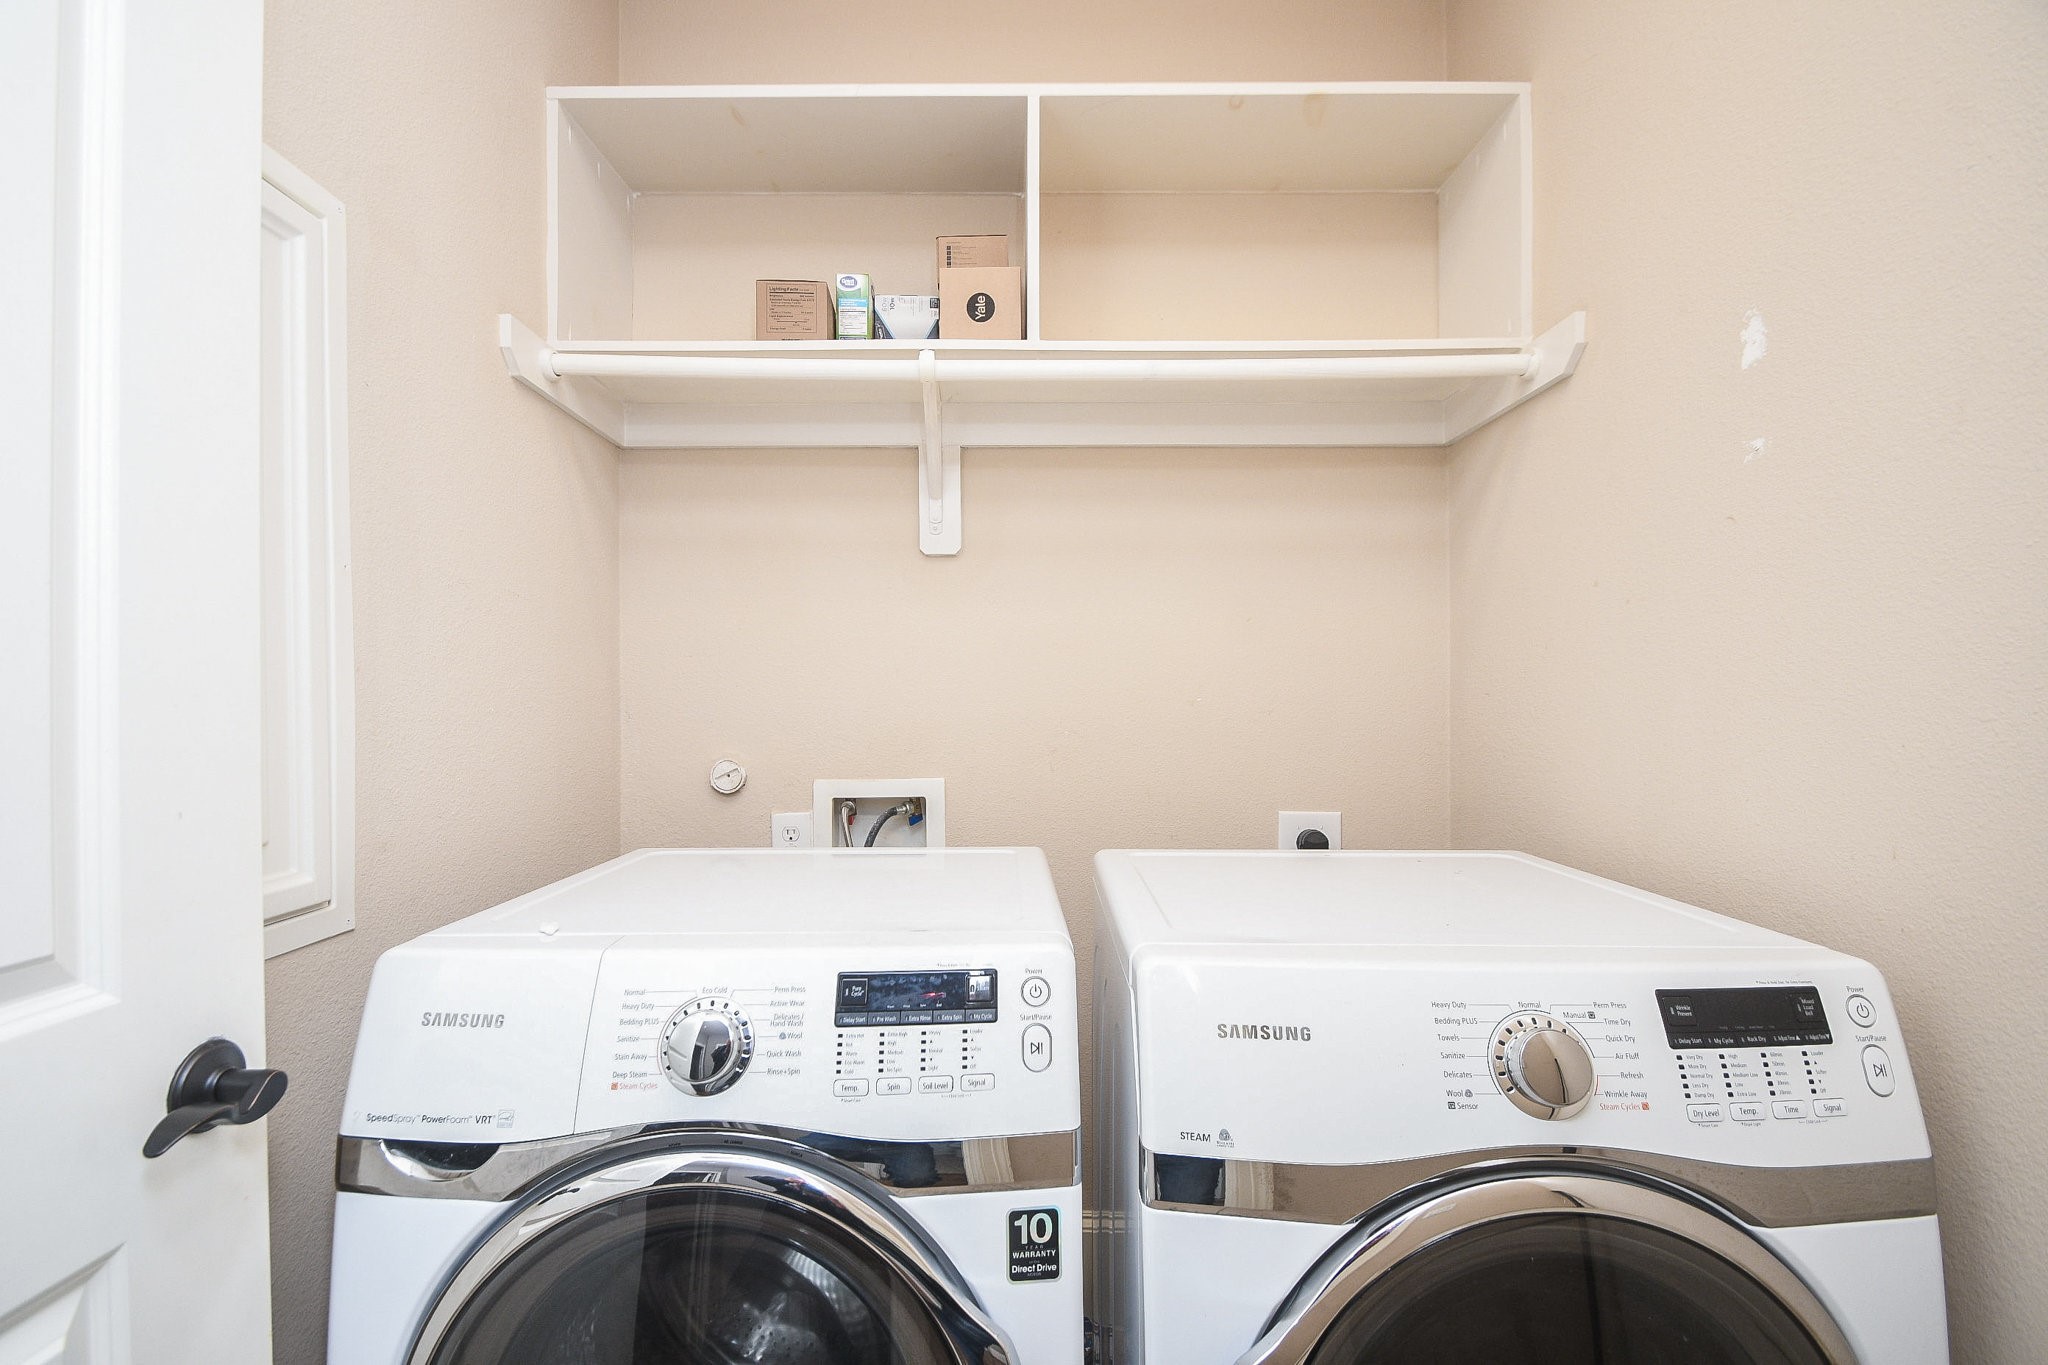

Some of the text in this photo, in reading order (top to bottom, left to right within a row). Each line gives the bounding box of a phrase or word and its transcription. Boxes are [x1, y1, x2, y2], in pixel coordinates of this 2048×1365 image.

[975, 295, 986, 320] Yale
[1845, 985, 1864, 993] Power
[641, 1003, 655, 1011] Duty
[1431, 1001, 1467, 1010] Heavy Duty
[1517, 1001, 1541, 1009] Normal
[1593, 1001, 1627, 1009] Perm Press
[1563, 1011, 1587, 1019] Manual
[421, 1012, 505, 1028] SAMSUNG
[1434, 1017, 1478, 1026] Bedding PLUS
[1604, 1018, 1631, 1027] Time Dry
[1217, 1023, 1311, 1042] SAMSUNG
[1437, 1033, 1460, 1041] Towels
[1605, 1035, 1636, 1044] Quick Dry
[1679, 1037, 1691, 1045] Delay
[1722, 1037, 1734, 1045] Cycle
[1855, 1034, 1887, 1042] Start/Pause
[614, 1053, 647, 1061] Stain Away
[766, 1050, 783, 1058] Quick
[1440, 1051, 1466, 1059] Sanitize
[1615, 1052, 1640, 1060] Air Fluff
[612, 1071, 628, 1079] Deep
[1443, 1070, 1473, 1078] Delicates
[1620, 1071, 1645, 1079] Refresh
[639, 1083, 658, 1091] Cycles
[887, 1082, 901, 1092] Spin
[922, 1081, 949, 1090] Soil Level
[967, 1078, 986, 1088] Signal
[841, 1084, 859, 1093] Temp.
[1446, 1089, 1464, 1097] Wool
[1604, 1090, 1648, 1099] Wrinkle Away
[1456, 1102, 1479, 1110] Sensor
[1600, 1102, 1641, 1111] Steam Cycles
[1784, 1105, 1799, 1114] Time
[1823, 1103, 1842, 1114] Signal
[1692, 1108, 1720, 1119] Dry Level
[1739, 1107, 1759, 1116] Temp.
[1180, 1131, 1211, 1142] STEAM
[1014, 1212, 1053, 1245] 10
[1012, 1249, 1057, 1259] WARRANTY
[1011, 1263, 1057, 1274] Direct Drive
